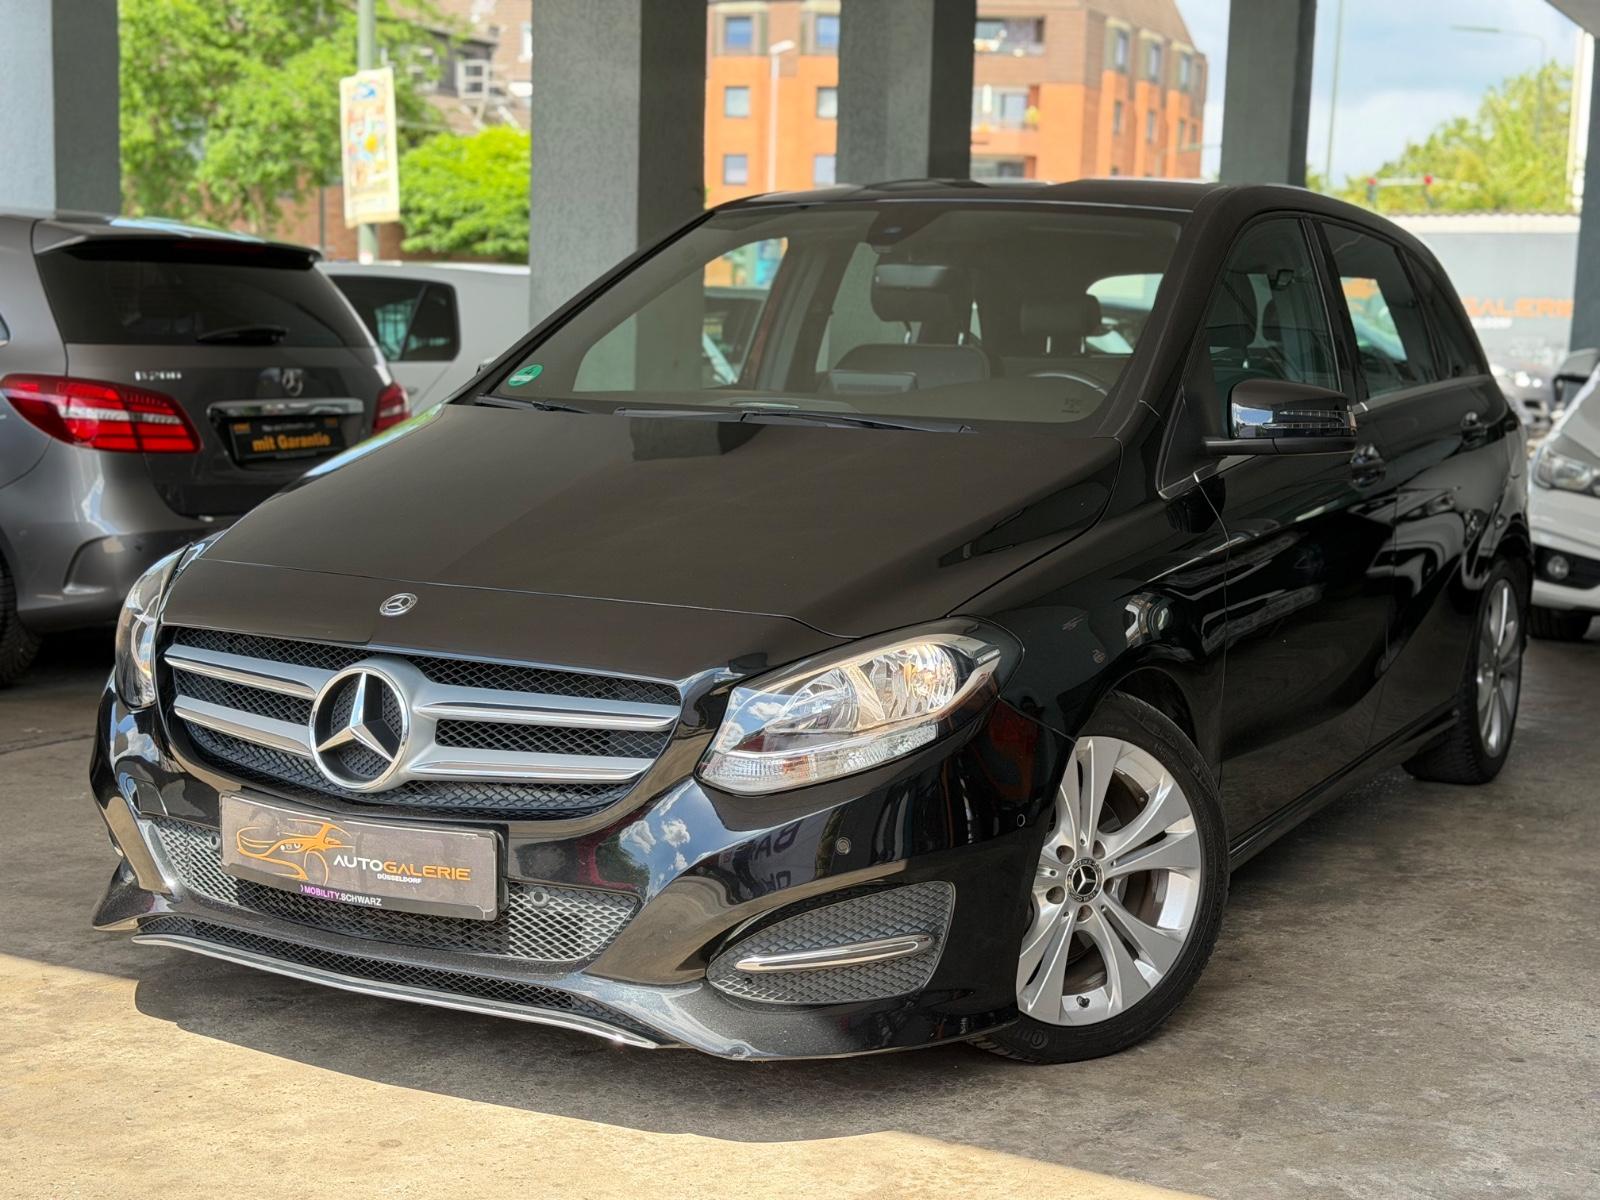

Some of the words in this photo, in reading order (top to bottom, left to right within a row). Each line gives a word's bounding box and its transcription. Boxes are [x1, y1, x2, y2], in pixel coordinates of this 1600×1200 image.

[251, 434, 276, 452] mit
[277, 431, 331, 450] Garantie
[333, 853, 471, 882] AUTOGALERIE
[376, 872, 422, 884] DÜSSELDORF
